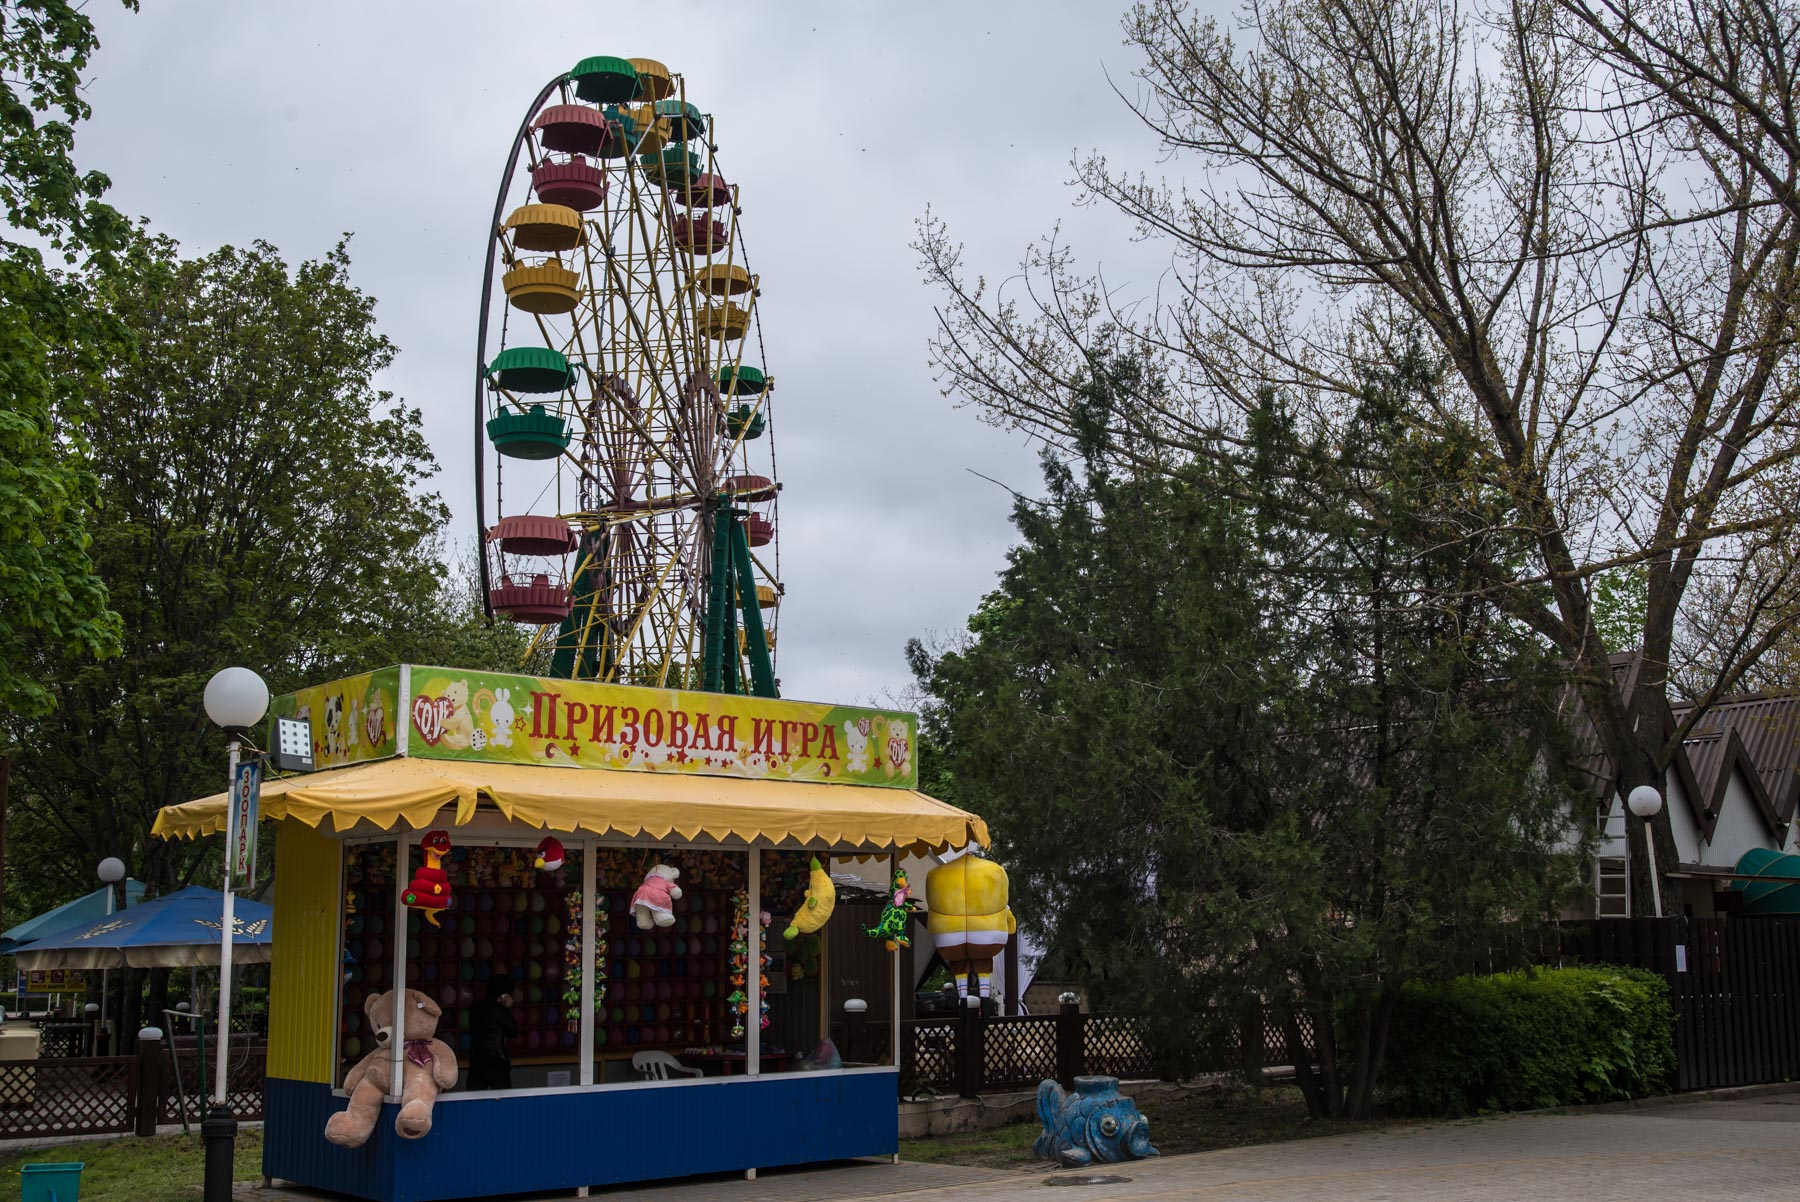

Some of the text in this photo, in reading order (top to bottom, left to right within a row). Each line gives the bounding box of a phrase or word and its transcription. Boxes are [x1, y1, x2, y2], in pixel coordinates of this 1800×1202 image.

[529, 690, 840, 761] ПРИЗОВАЯ ИГРА
[238, 771, 250, 871] ЗООПАРК
